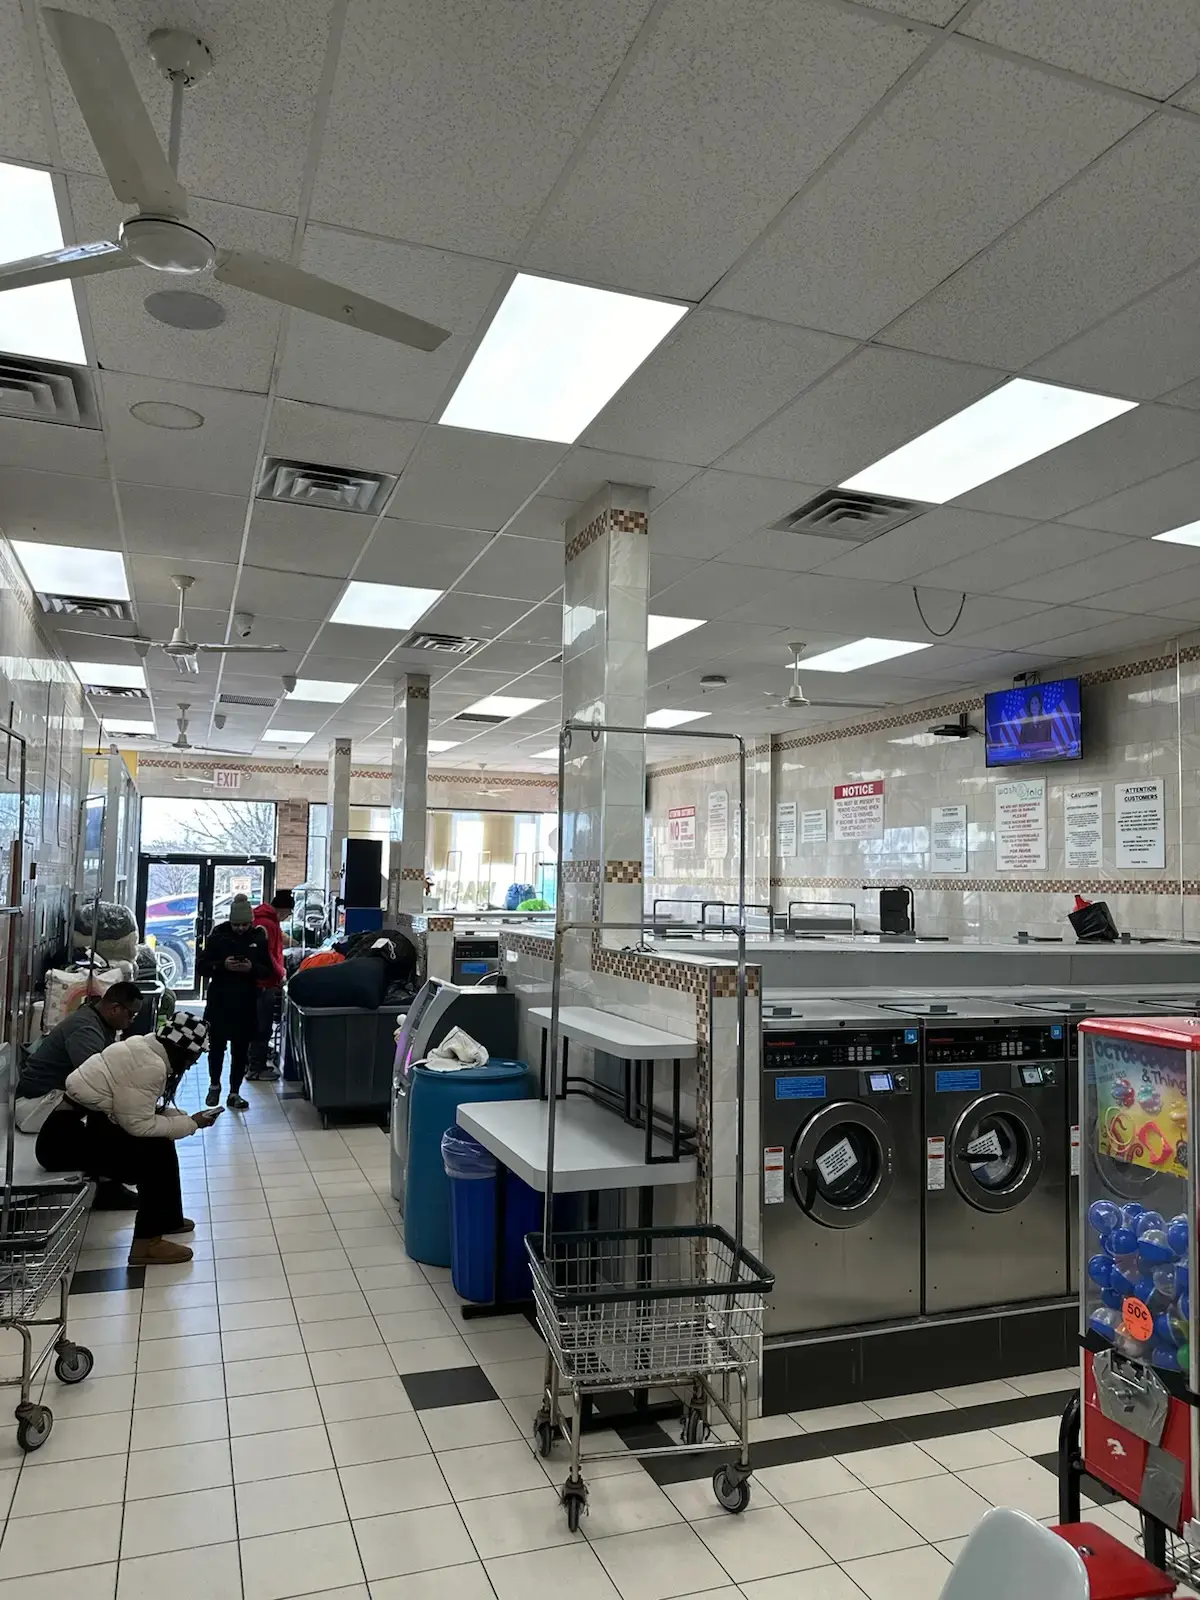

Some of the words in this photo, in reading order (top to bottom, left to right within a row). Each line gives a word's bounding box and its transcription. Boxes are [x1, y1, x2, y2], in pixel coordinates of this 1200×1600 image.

[217, 772, 239, 787] EXIT
[842, 784, 874, 797] NOTICE
[1142, 1068, 1152, 1083] &
[1127, 1303, 1148, 1320] 50¢
